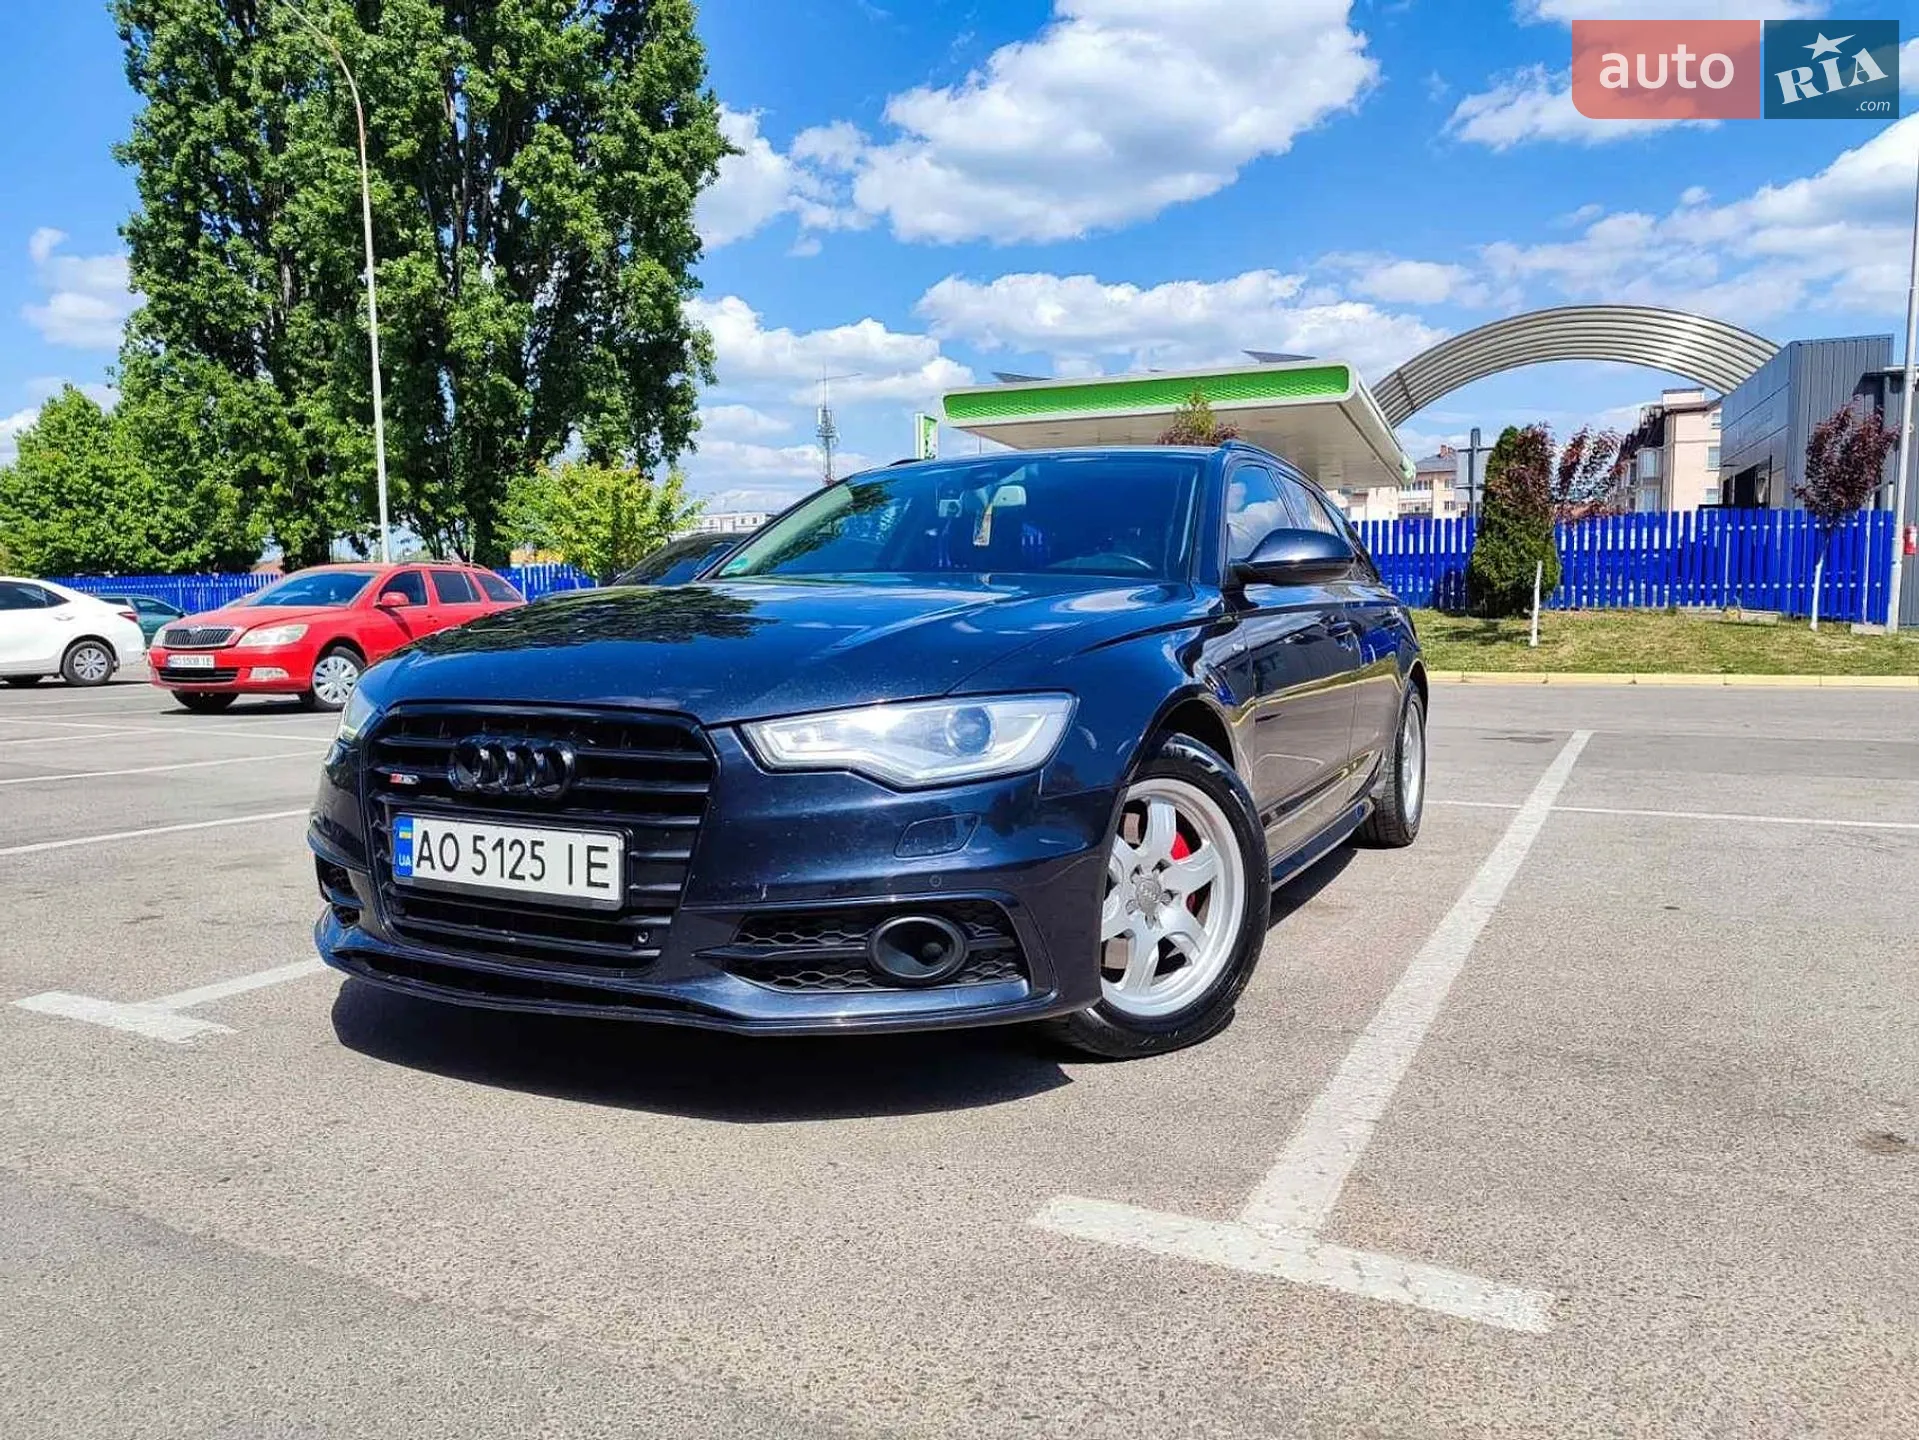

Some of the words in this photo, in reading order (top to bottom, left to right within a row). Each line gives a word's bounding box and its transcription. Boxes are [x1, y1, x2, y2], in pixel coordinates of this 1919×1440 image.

[398, 854, 412, 867] UA
[416, 830, 460, 873] AO
[471, 834, 546, 882] 5125
[568, 843, 610, 889] IE
